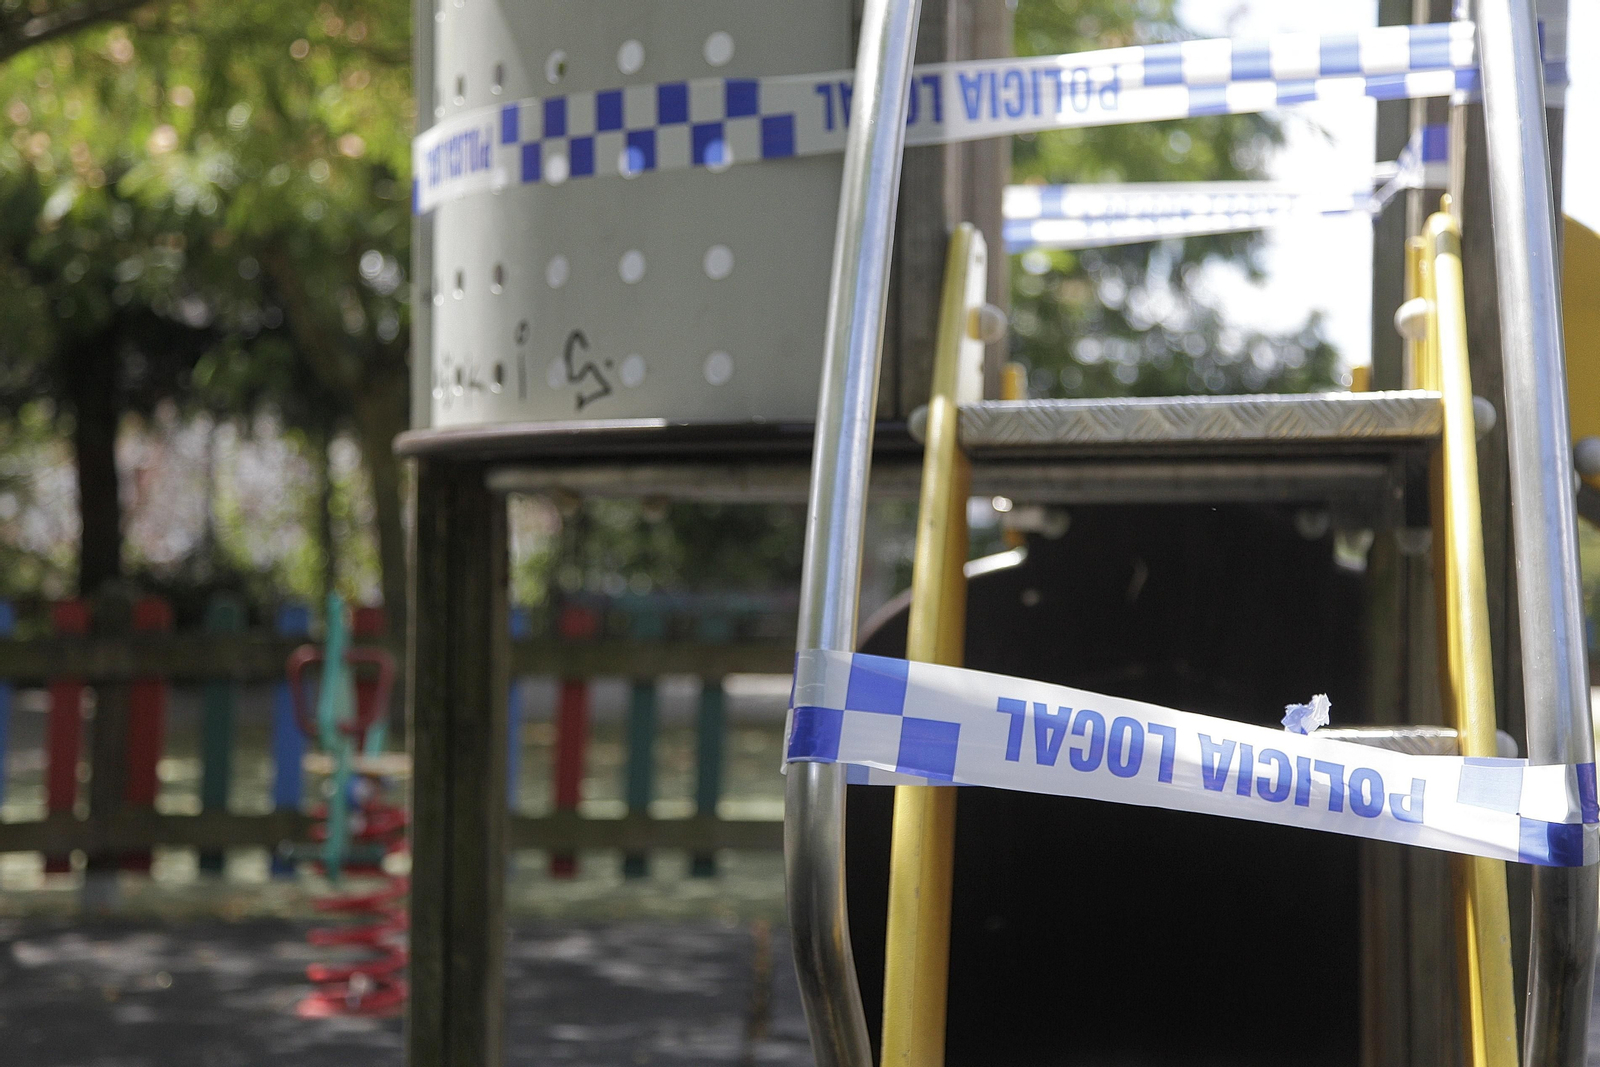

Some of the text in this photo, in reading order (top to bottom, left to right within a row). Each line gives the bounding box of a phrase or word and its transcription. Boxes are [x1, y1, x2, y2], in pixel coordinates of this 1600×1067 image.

[815, 64, 1121, 131] POLICIA LAL
[997, 697, 1426, 825] POLICIA LOCAL
